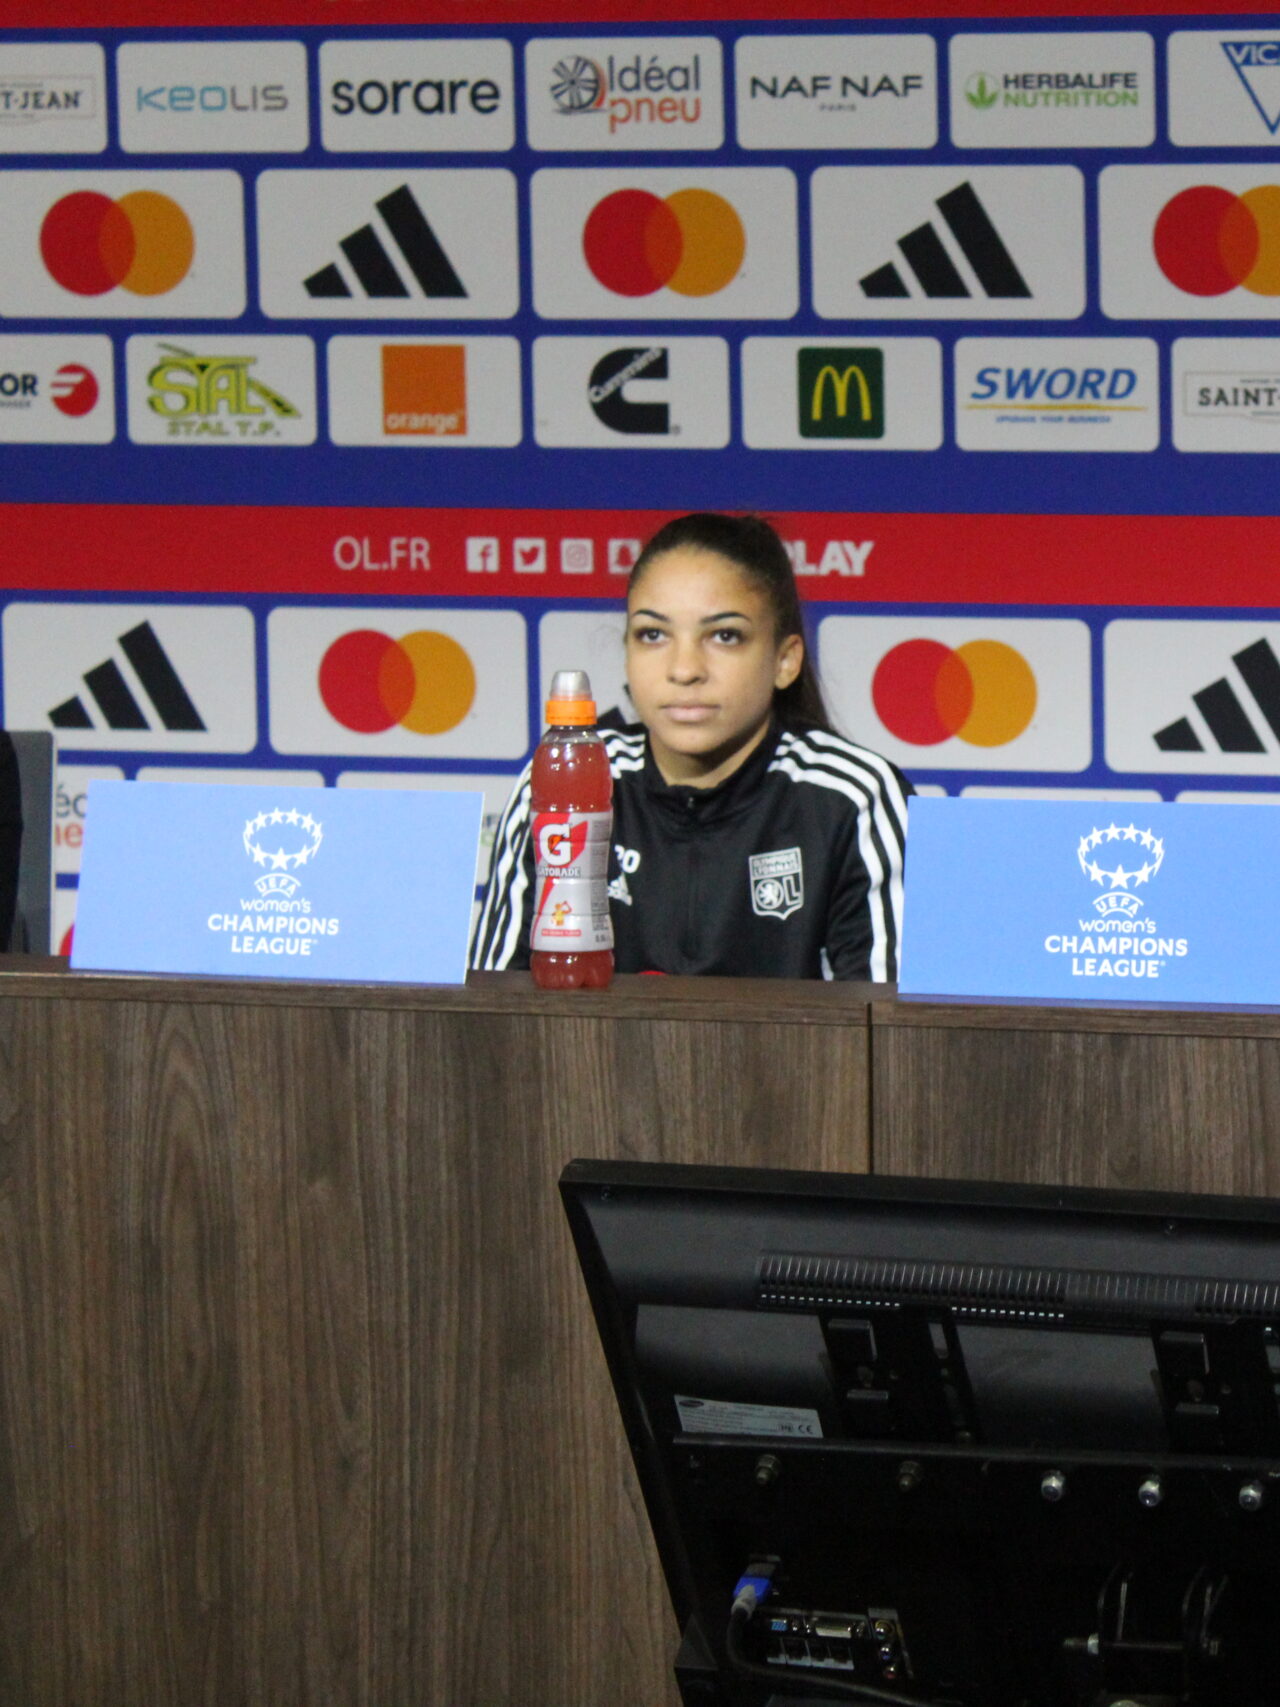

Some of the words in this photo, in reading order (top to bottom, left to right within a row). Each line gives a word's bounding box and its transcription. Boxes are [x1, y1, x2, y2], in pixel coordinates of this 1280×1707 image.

[608, 54, 700, 92] Idéal
[1003, 73, 1138, 90] HERBALIFE
[331, 78, 500, 115] sorare
[750, 76, 831, 99] NAF
[841, 75, 923, 97] NAF
[1003, 90, 1139, 108] NUTRITION
[609, 95, 700, 134] pneu
[971, 367, 1137, 400] SWORD
[167, 421, 230, 436] STAL
[386, 412, 459, 433] orange
[334, 536, 430, 571] OL.FR
[256, 876, 297, 895] UEFA
[240, 896, 312, 914] women's
[1095, 895, 1139, 915] UEFA
[207, 913, 340, 936] CHAMPIONS
[1078, 917, 1157, 934] women's
[231, 935, 312, 956] LEAGUE
[1044, 935, 1188, 957] CHAMPIONS
[1072, 958, 1160, 978] LEAGUE
